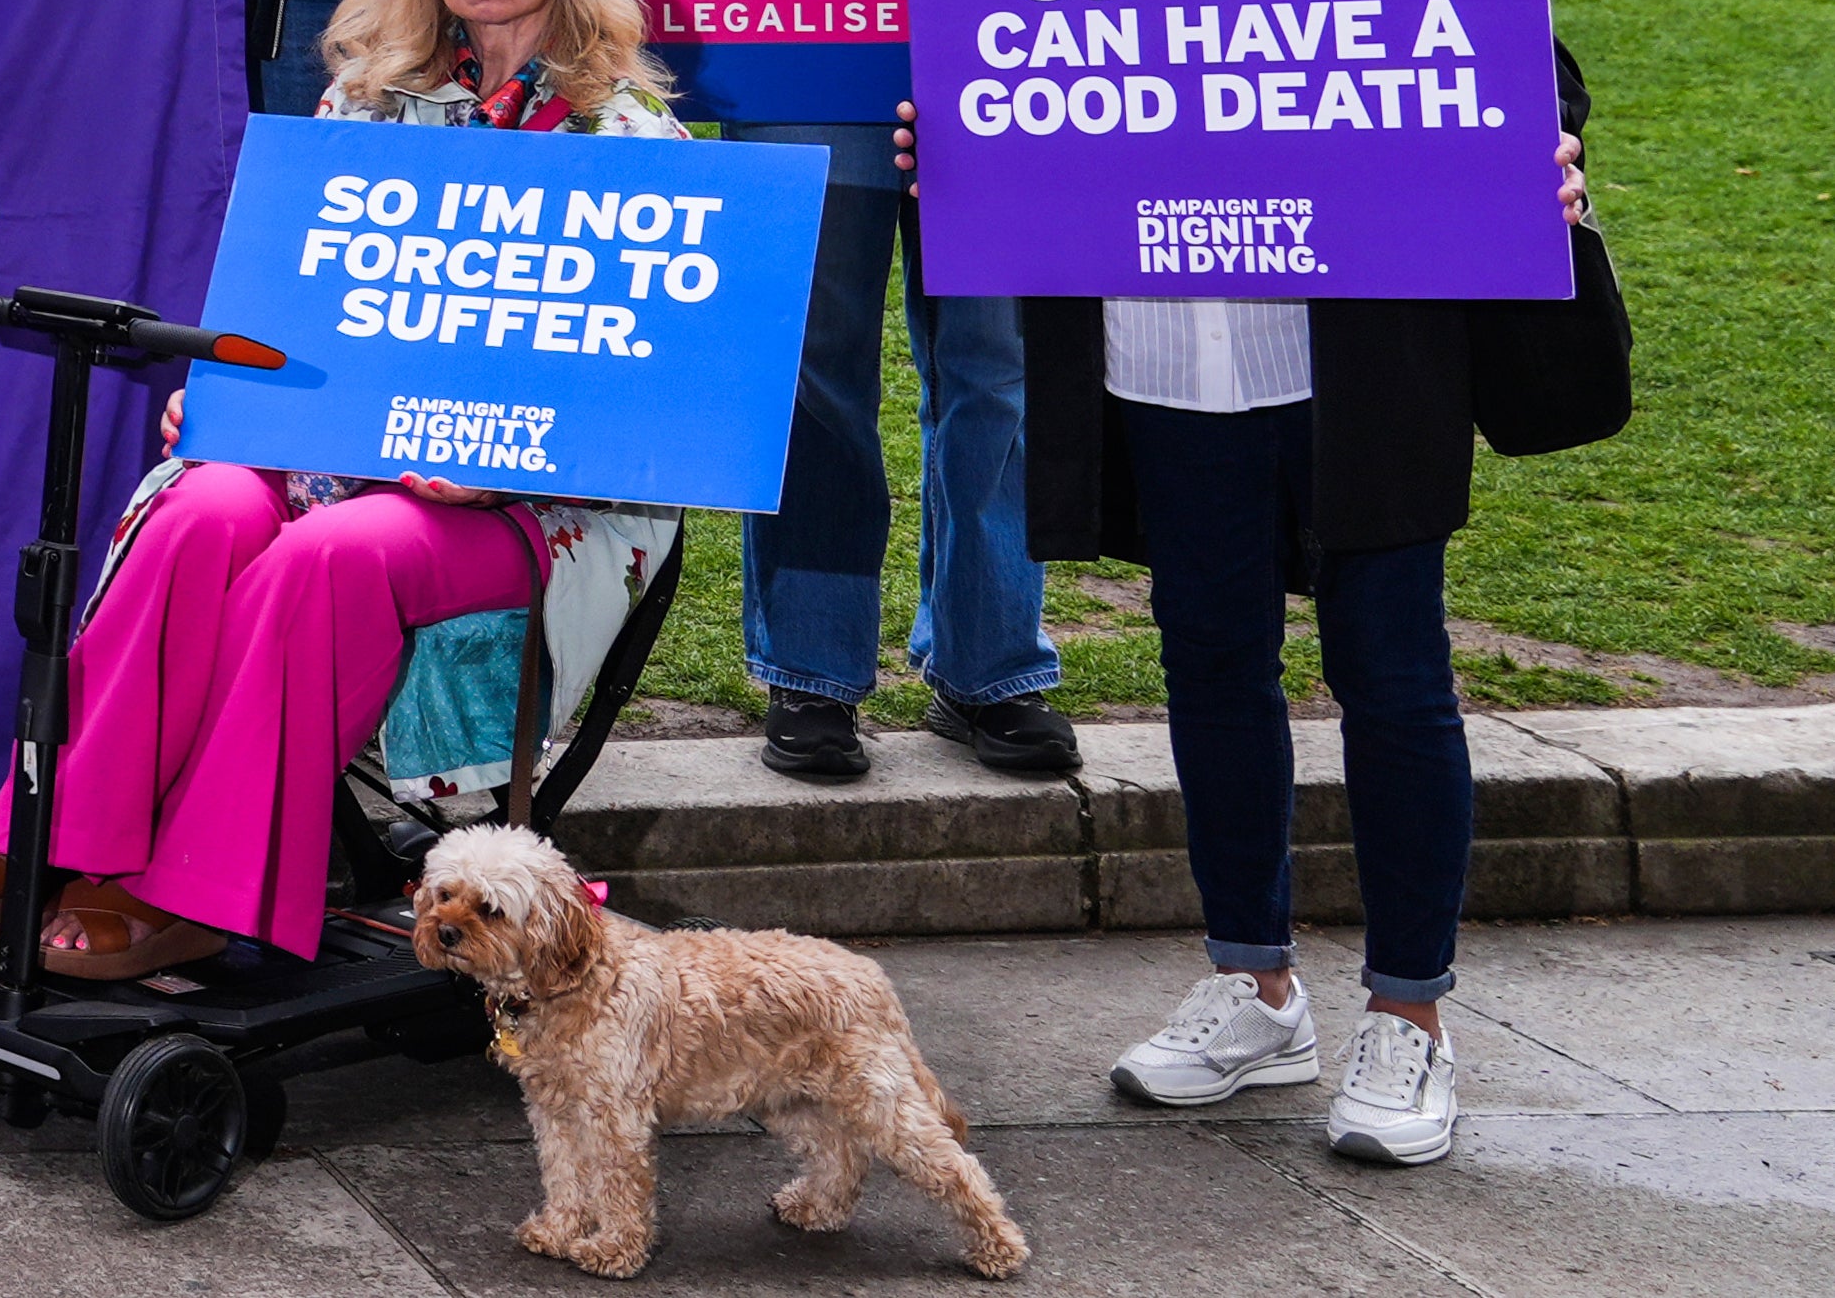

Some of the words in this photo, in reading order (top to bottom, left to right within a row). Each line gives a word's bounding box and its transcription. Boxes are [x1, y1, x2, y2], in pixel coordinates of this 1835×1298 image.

[663, 2, 900, 32] LEGALISE
[977, 9, 1140, 69] CAN
[1165, 0, 1386, 64] HAVE
[959, 75, 1177, 136] GOOD
[1202, 67, 1505, 132] DEATH.
[317, 175, 418, 227] SO
[437, 182, 544, 236] I'M
[563, 190, 723, 245] NOT
[1137, 199, 1258, 216] CAMPAIGN
[1266, 198, 1314, 215] FOR
[1137, 216, 1313, 245] DIGNITY
[299, 228, 596, 294] FORCED
[619, 249, 719, 303] TO
[1139, 246, 1181, 273] IN
[1188, 245, 1329, 274] DYING.
[336, 287, 653, 358] SUFFER.
[385, 409, 554, 447] DIGNITY
[391, 395, 506, 419] CAMPAIGN
[511, 405, 556, 423] FOR
[380, 434, 422, 461] IN
[425, 438, 557, 473] DYING.
